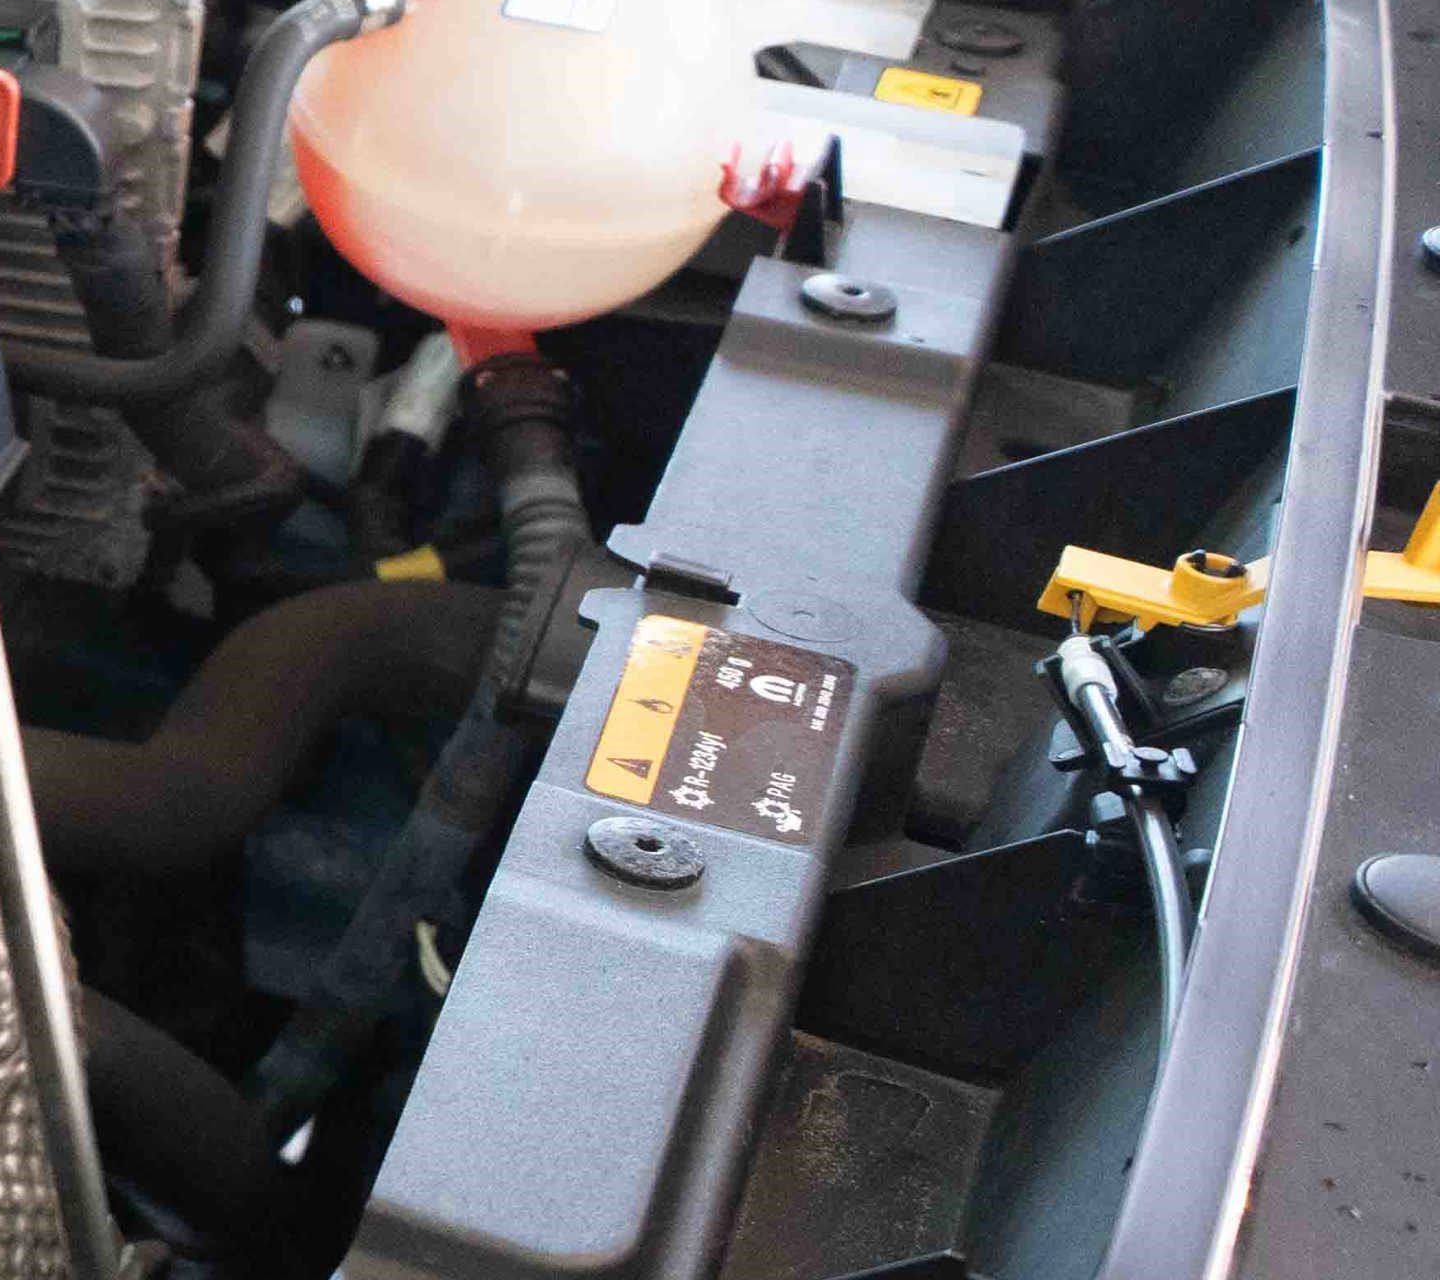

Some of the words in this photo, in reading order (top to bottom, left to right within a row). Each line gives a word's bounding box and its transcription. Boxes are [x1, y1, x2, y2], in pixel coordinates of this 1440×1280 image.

[715, 665, 745, 690] 450
[683, 730, 728, 788] R-1234yf
[766, 771, 797, 799] PAG
